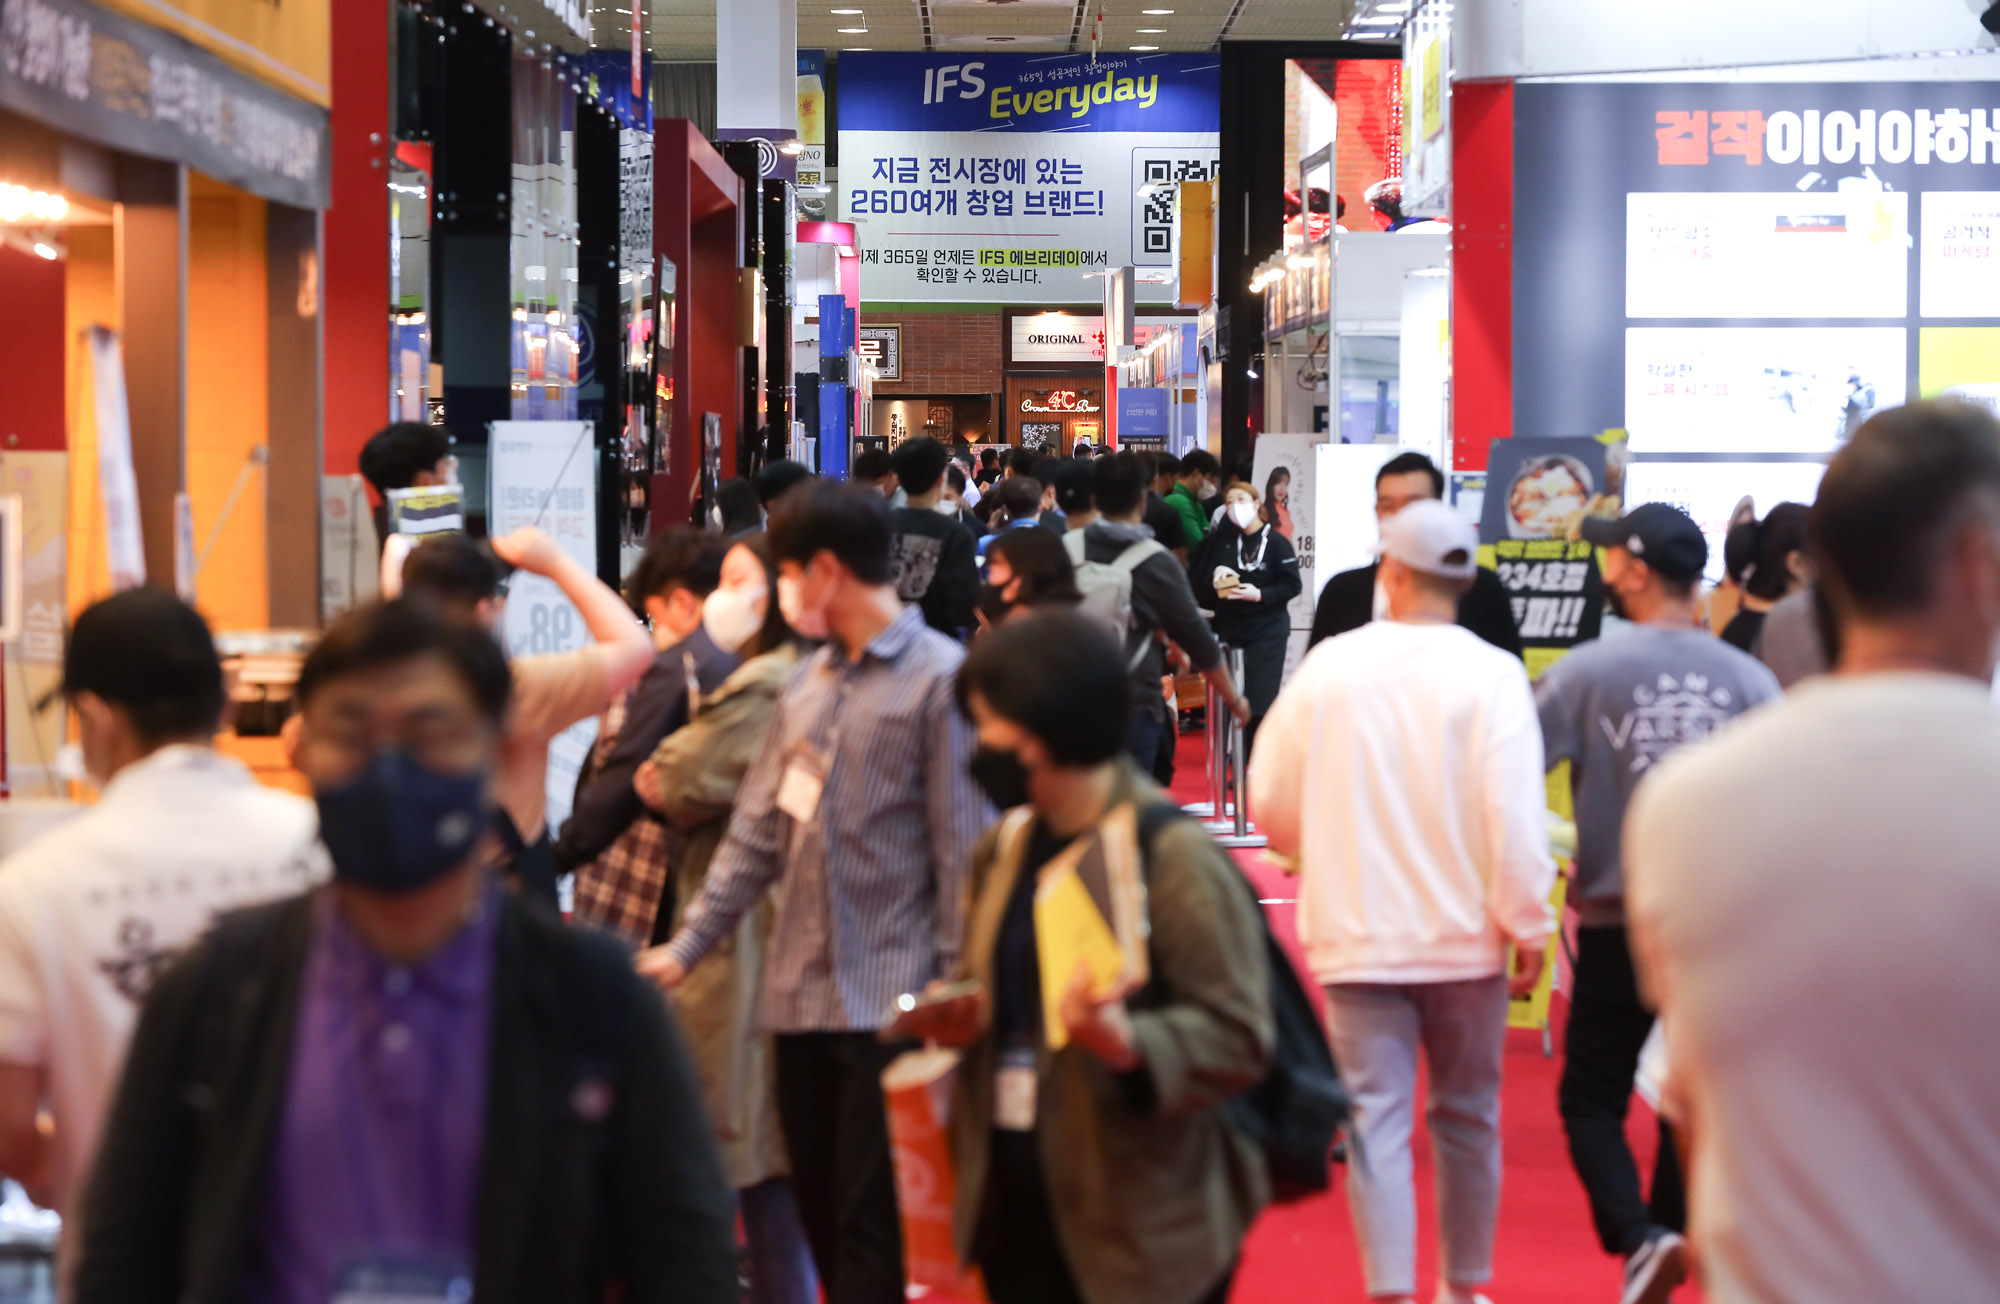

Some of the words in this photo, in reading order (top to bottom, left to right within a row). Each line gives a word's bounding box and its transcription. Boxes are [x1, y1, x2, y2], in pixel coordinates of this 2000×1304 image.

[1047, 65, 1080, 80] 성공적인
[923, 62, 986, 105] IFS
[990, 70, 1158, 118] Everyday
[1655, 108, 2000, 165] 걸작이어야하
[872, 157, 919, 183] 지금
[929, 157, 1026, 185] 전시장에
[1036, 158, 1084, 185] 있는
[851, 189, 957, 216] 260여개
[966, 190, 1013, 216] 창업
[1023, 190, 1104, 217] 브랜드!
[884, 250, 928, 264] 365일
[934, 250, 975, 264] 언제든
[980, 250, 1004, 264] IFS
[1010, 250, 1107, 265] 에브리데이에서
[917, 268, 958, 284] 확인할
[963, 269, 977, 284] 수
[982, 268, 1042, 284] 있습니다.
[1028, 334, 1085, 344] ORIGINAL
[1021, 399, 1049, 412] Crown
[1076, 399, 1100, 412] Beer
